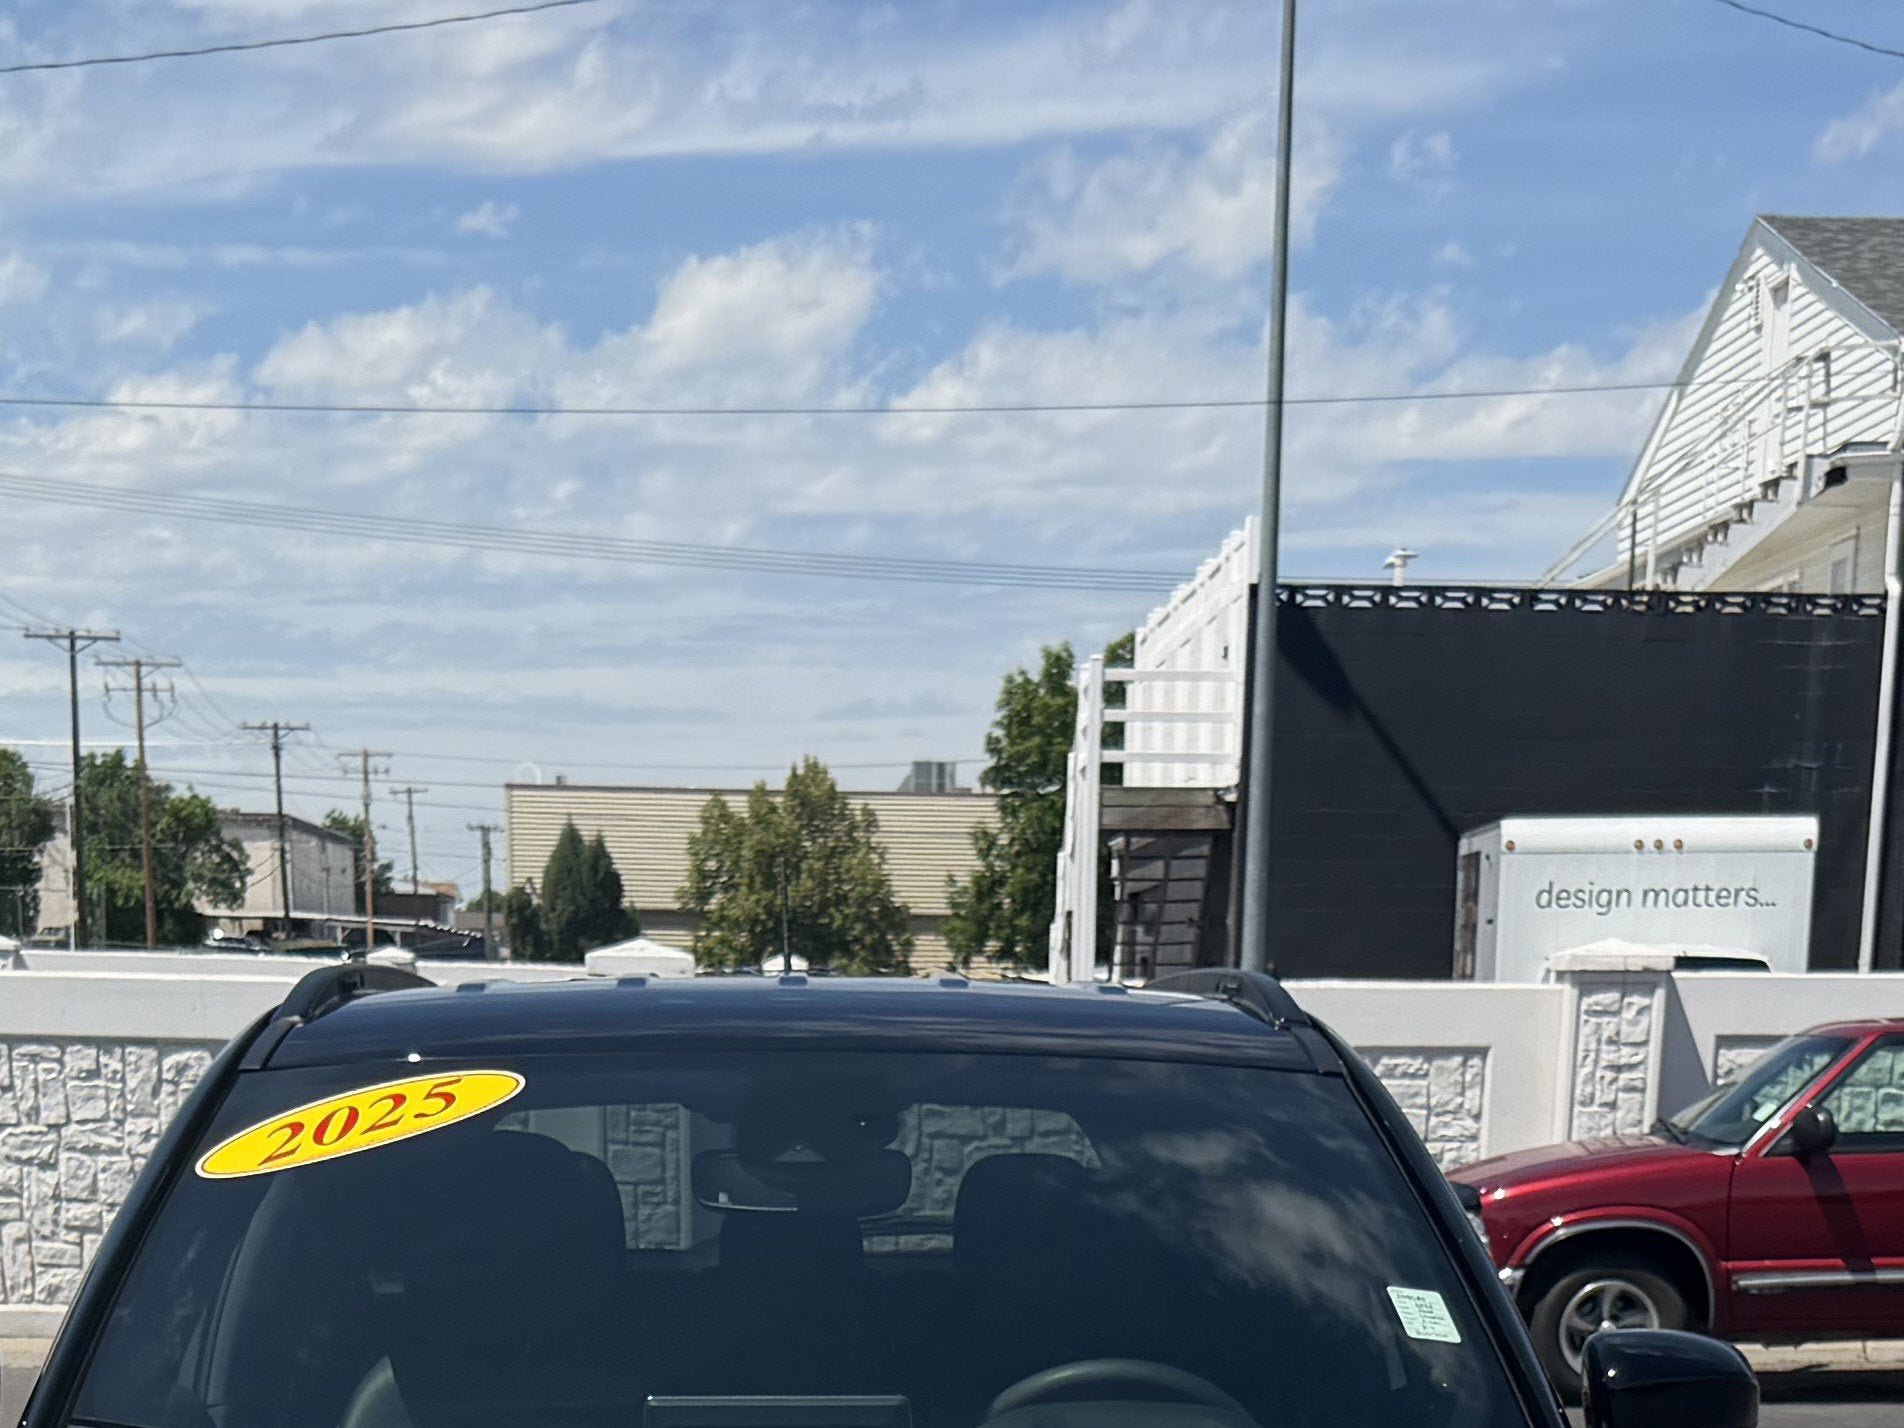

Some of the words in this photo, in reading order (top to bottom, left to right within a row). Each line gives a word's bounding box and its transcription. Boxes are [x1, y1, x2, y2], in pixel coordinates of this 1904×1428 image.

[1536, 881, 1632, 916] design
[1642, 884, 1777, 908] matters...
[257, 1075, 463, 1167] 2025
